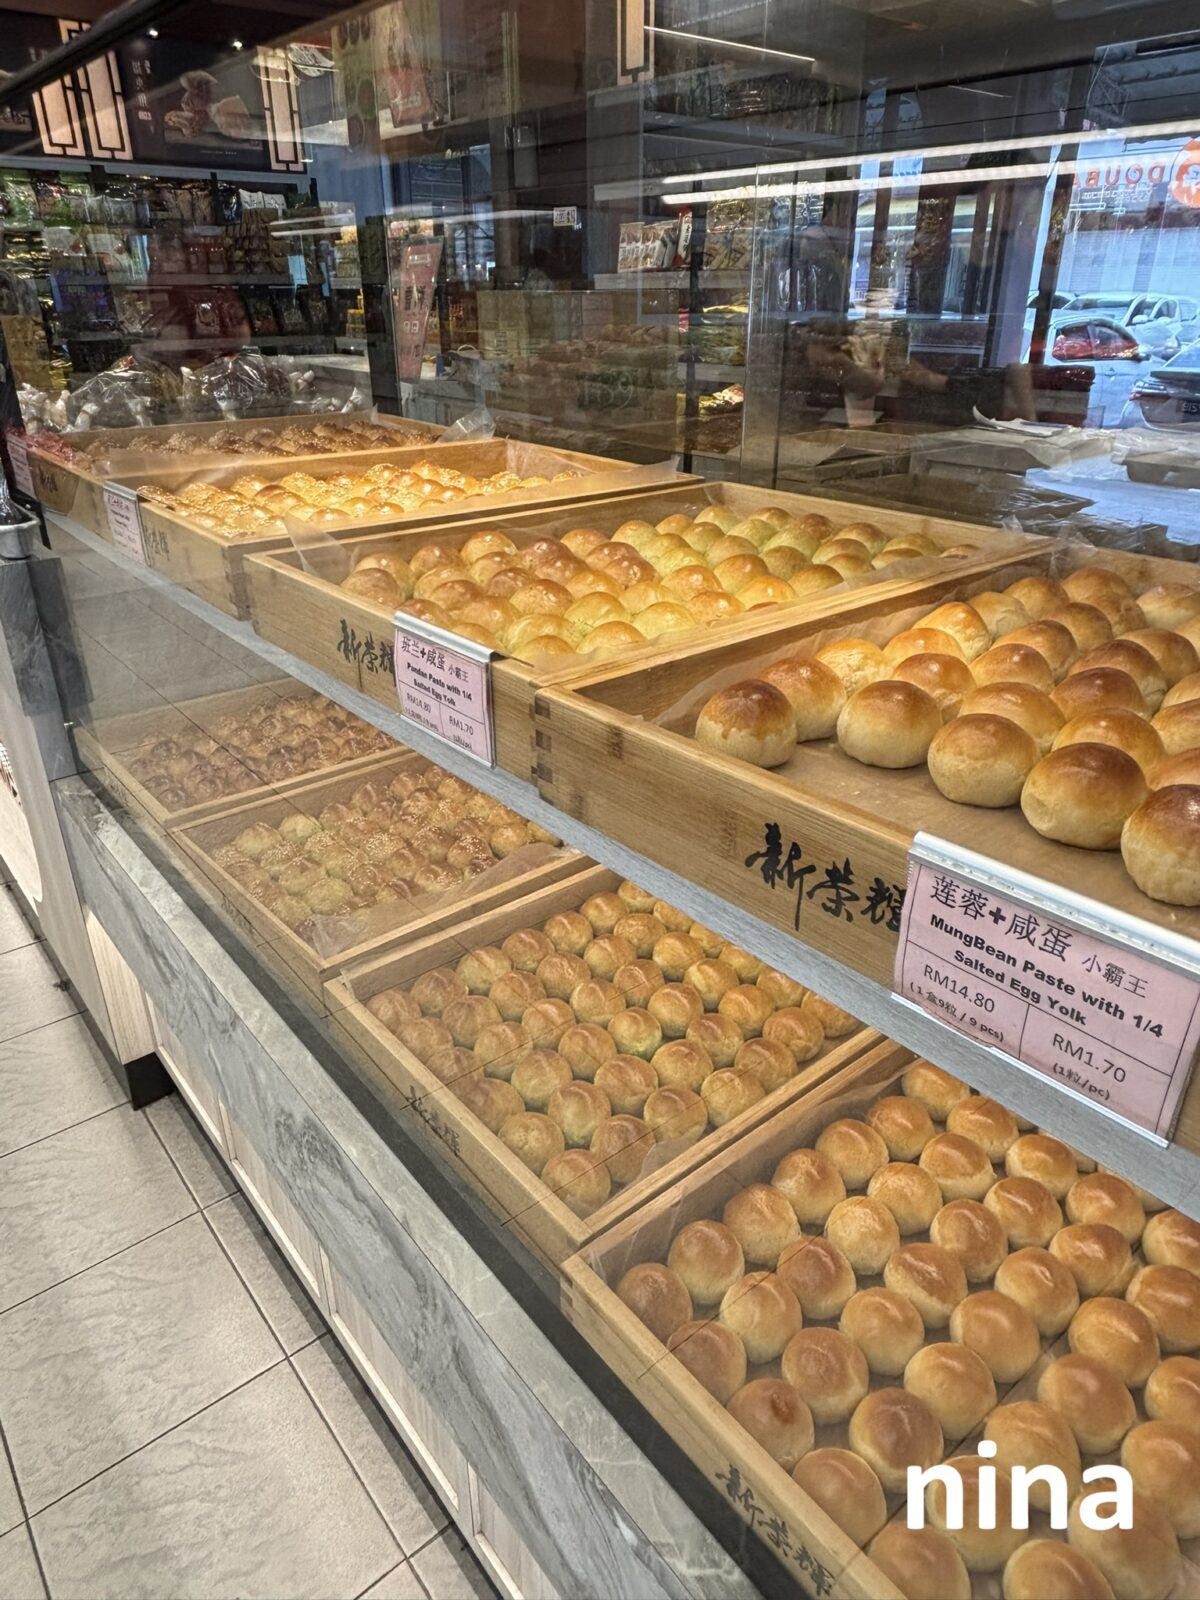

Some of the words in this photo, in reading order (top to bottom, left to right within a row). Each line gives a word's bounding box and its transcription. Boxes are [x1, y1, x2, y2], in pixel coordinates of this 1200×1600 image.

[407, 662, 428, 680] Pandan
[428, 673, 446, 690] Paste
[446, 683, 461, 696] with
[462, 689, 472, 702] 1/4
[431, 687, 443, 702] Egg
[449, 714, 474, 736] RM1.70
[930, 875, 1073, 962] 莲蓉+咸蛋
[1081, 954, 1149, 999] 小霸王
[923, 964, 995, 1014] RM14.80
[929, 913, 1017, 968] MungBean
[1021, 960, 1076, 996] Paste
[1081, 990, 1125, 1021] with
[1132, 1013, 1164, 1039] 1/4
[953, 949, 1006, 984] Salted
[1009, 977, 1042, 1005] Egg
[1047, 995, 1087, 1026] Yolk
[1052, 1032, 1127, 1084] RM1.70
